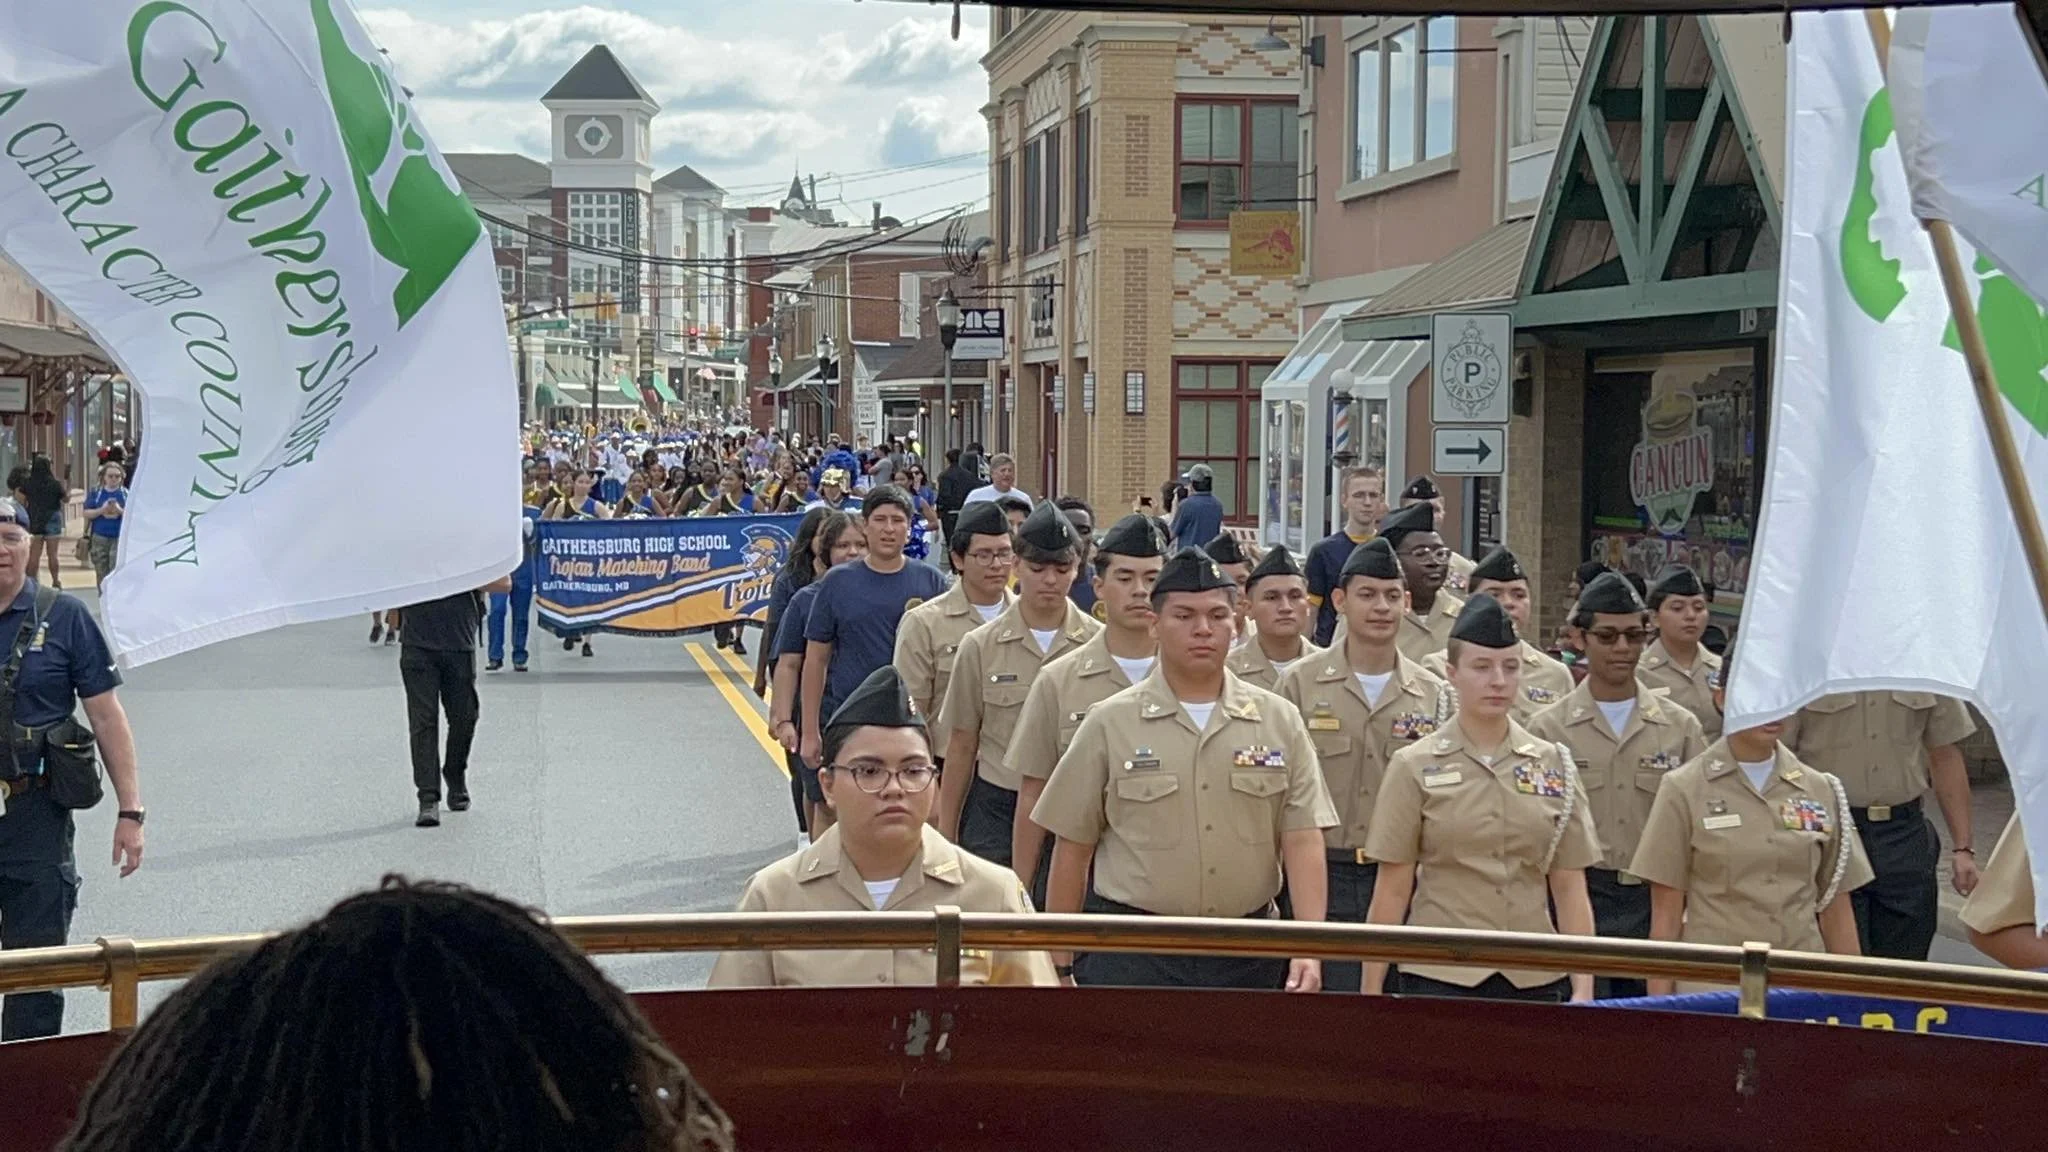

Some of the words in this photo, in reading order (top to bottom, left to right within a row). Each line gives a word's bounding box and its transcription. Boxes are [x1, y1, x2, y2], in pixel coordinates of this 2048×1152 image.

[2008, 173, 2047, 210] A
[6, 122, 203, 306] CHARACTER
[1449, 345, 1492, 362] PUBLIC
[1464, 362, 1481, 383] P
[1445, 377, 1497, 399] PARKING
[1633, 429, 1710, 499] CANCUN
[542, 537, 641, 555] GAITHERSBURG
[645, 537, 675, 553] HIGH
[679, 535, 731, 551] SCHOOL
[550, 555, 594, 580] Trojan
[597, 556, 668, 580] Marching
[671, 552, 711, 575] Band
[615, 582, 629, 591] MD
